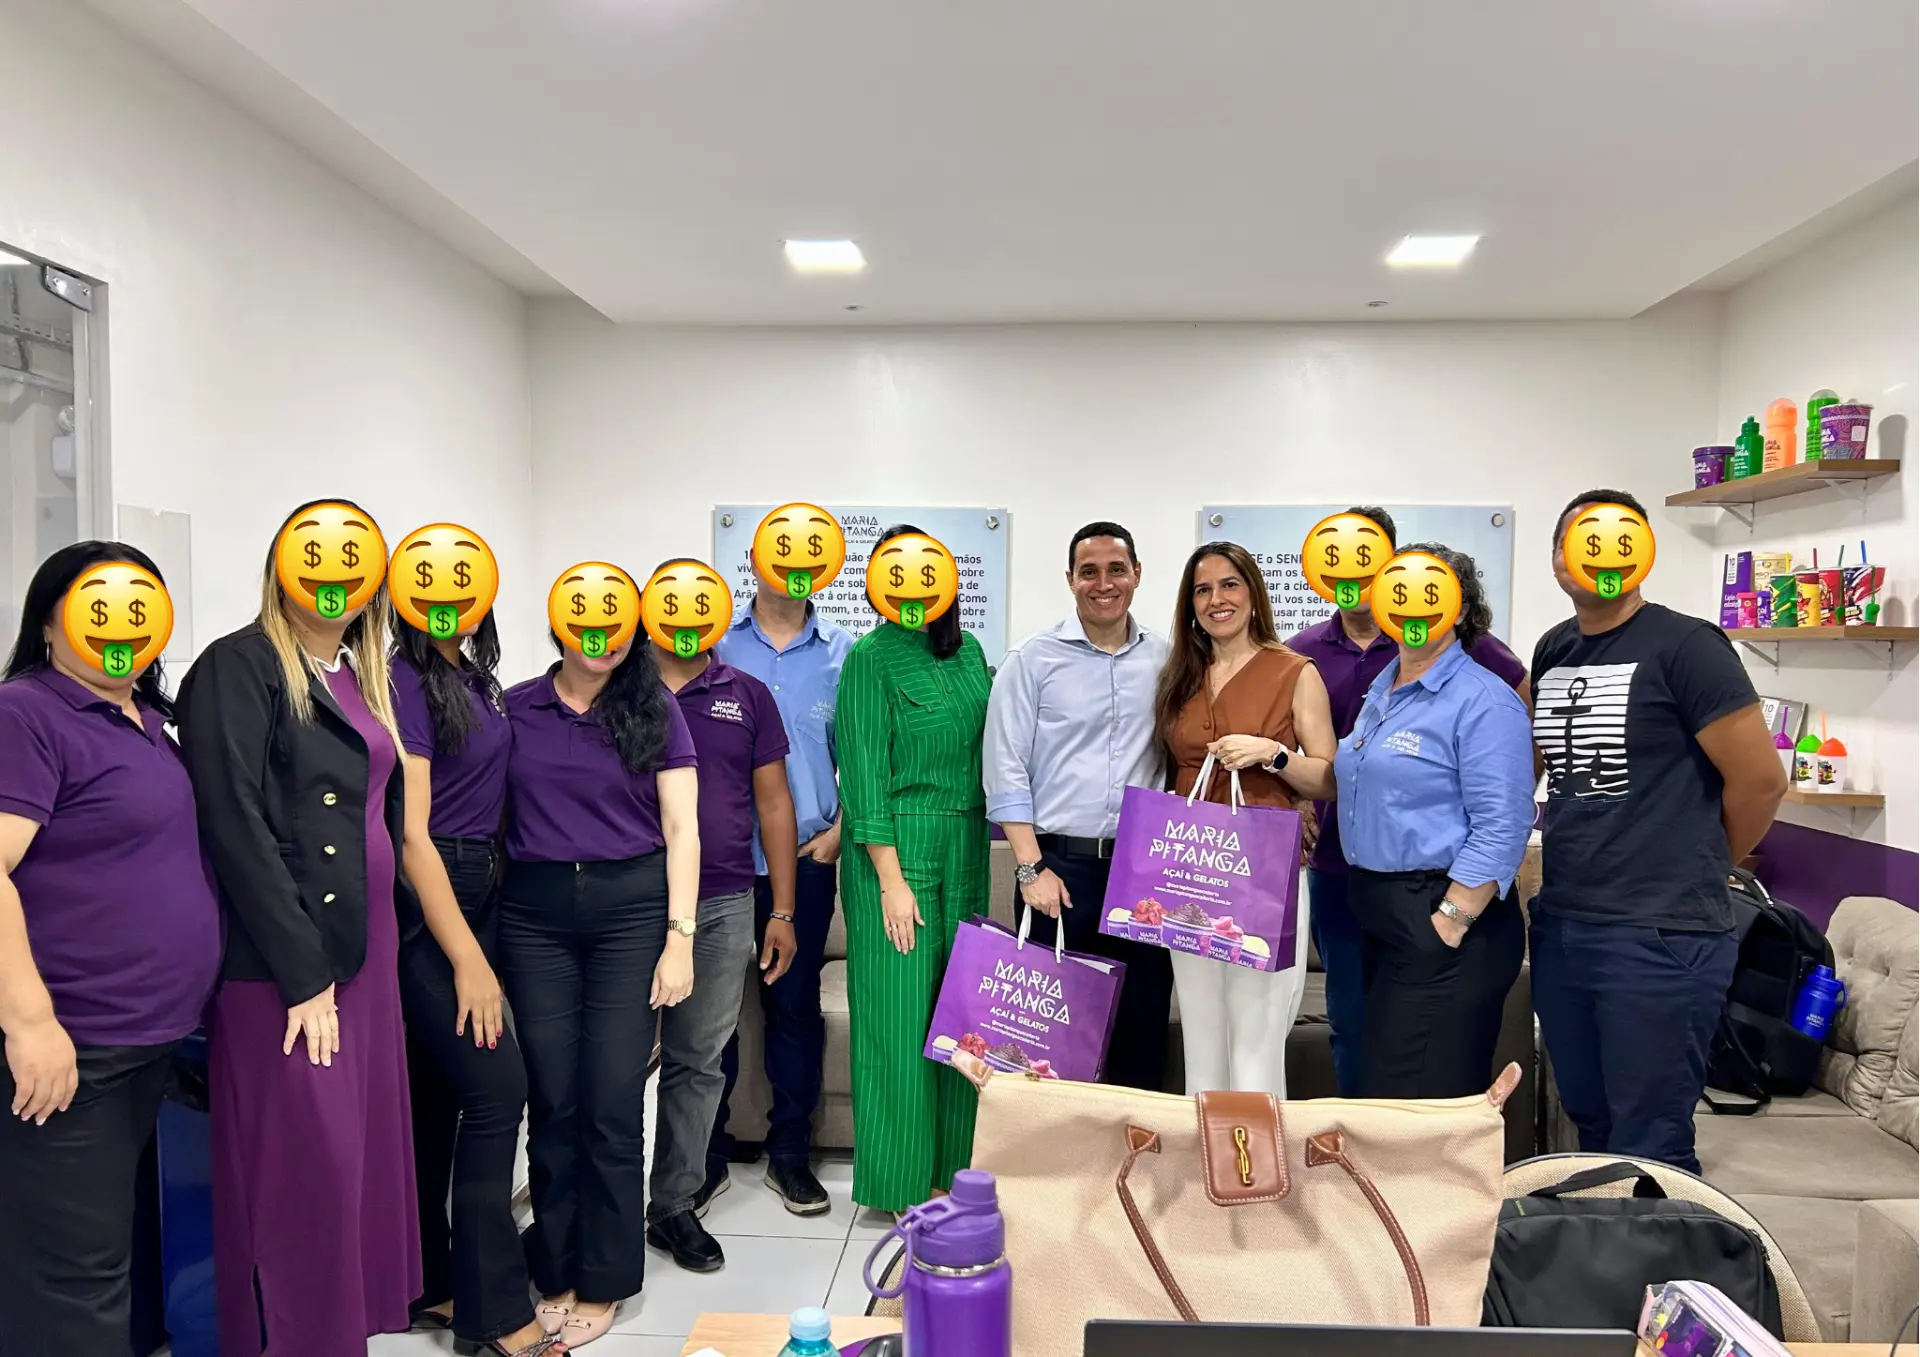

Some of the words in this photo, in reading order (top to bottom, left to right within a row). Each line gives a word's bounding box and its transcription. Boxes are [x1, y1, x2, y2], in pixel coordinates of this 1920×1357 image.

[841, 515, 879, 526] MARIA
[840, 526, 887, 537] ITANGA
[845, 552, 864, 562] uão
[954, 553, 982, 564] mãos
[1266, 556, 1273, 564] o
[1276, 553, 1302, 564] SEN
[737, 563, 752, 573] viv
[843, 566, 867, 575] com
[957, 568, 985, 577] sobre
[1260, 567, 1282, 577] ham
[1285, 569, 1298, 577] os
[847, 578, 866, 588] sob
[966, 580, 979, 590] de
[1283, 582, 1290, 591] a
[1293, 580, 1314, 591] cid
[836, 591, 858, 601] orla
[958, 593, 988, 603] Como
[1270, 594, 1282, 604] til
[1284, 596, 1304, 604] vos
[816, 606, 850, 615] rmom,
[853, 606, 860, 614] e
[862, 606, 874, 614] co
[1273, 608, 1298, 617] usar
[959, 621, 976, 629] ena
[1274, 621, 1295, 631] sim
[1165, 819, 1241, 851] MARIA
[1149, 838, 1252, 877] PITANGA
[1162, 867, 1185, 879] AÇAÍ
[1184, 871, 1192, 880] &
[1193, 873, 1230, 888] GELATOS
[994, 958, 1063, 1000] MARIA
[978, 975, 1071, 1025] PITANGA
[990, 1006, 1010, 1019] AÇAÍ
[1017, 1016, 1050, 1033] GELATOS
